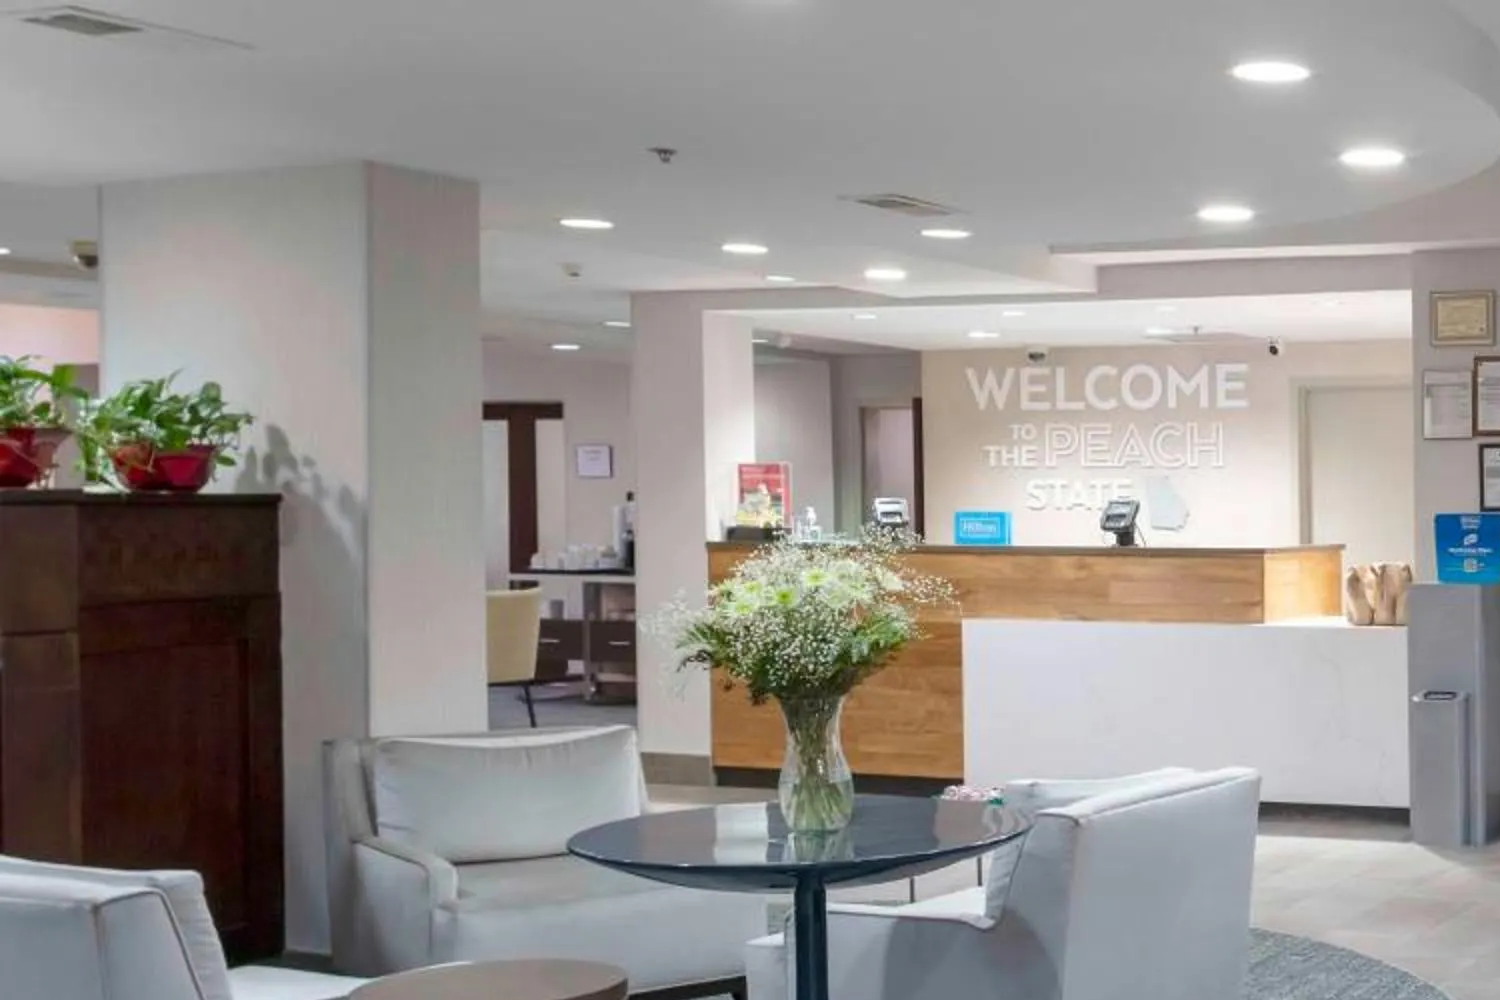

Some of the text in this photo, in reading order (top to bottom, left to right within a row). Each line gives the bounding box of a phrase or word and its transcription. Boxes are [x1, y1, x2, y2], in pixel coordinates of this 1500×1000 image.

[964, 363, 1250, 411] WELCOME
[982, 421, 1225, 468] THE PEACH
[1009, 423, 1038, 441] TO
[1025, 478, 1134, 511] STATE
